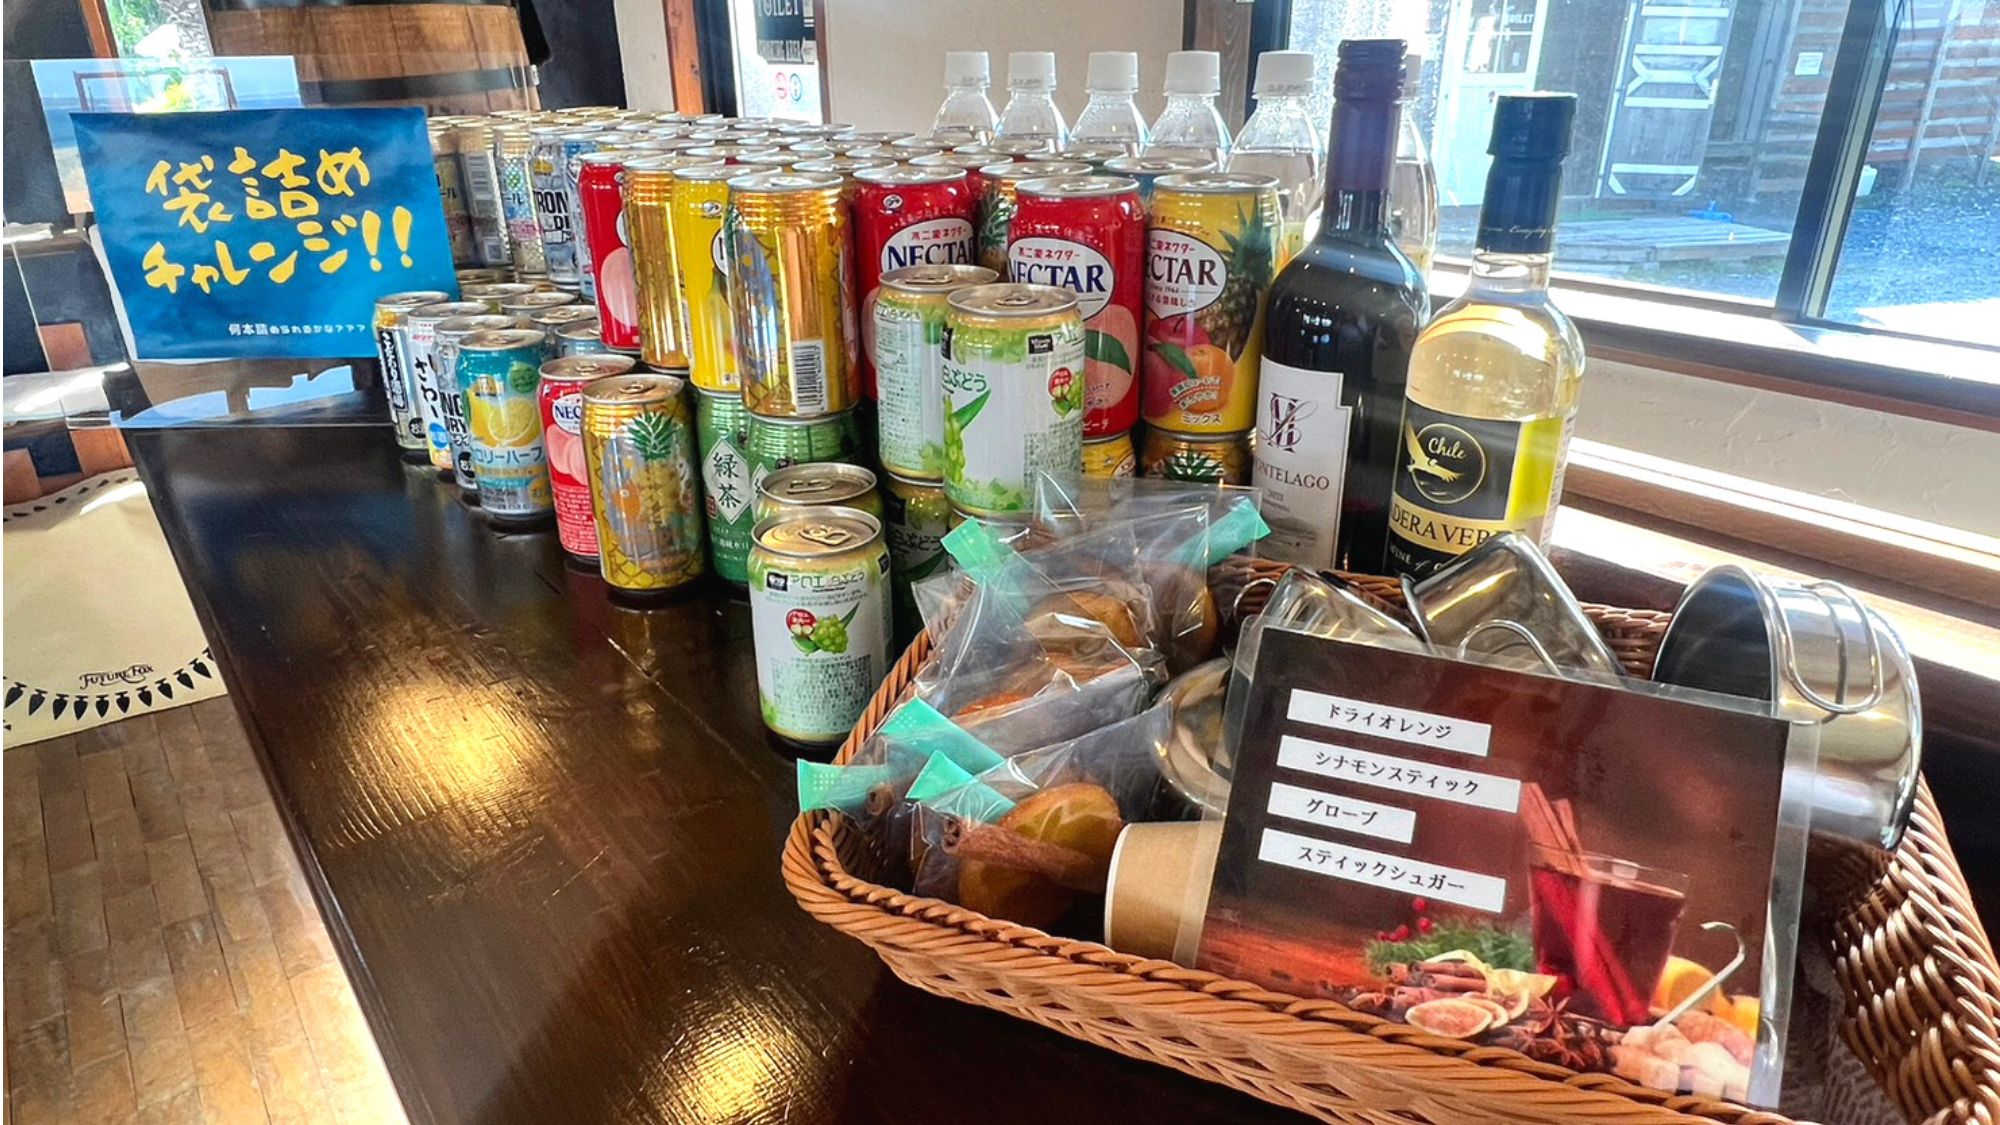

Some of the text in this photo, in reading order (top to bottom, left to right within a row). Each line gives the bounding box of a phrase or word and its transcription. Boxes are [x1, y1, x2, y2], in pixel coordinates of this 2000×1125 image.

[146, 146, 371, 233] 袋詰め
[1428, 435, 1468, 460] Chile
[712, 452, 742, 509] 緑茶
[1329, 703, 1452, 739] ドライオレンジ
[1315, 750, 1479, 796] シナモンスティック
[1296, 846, 1466, 891] スティックシュガー
